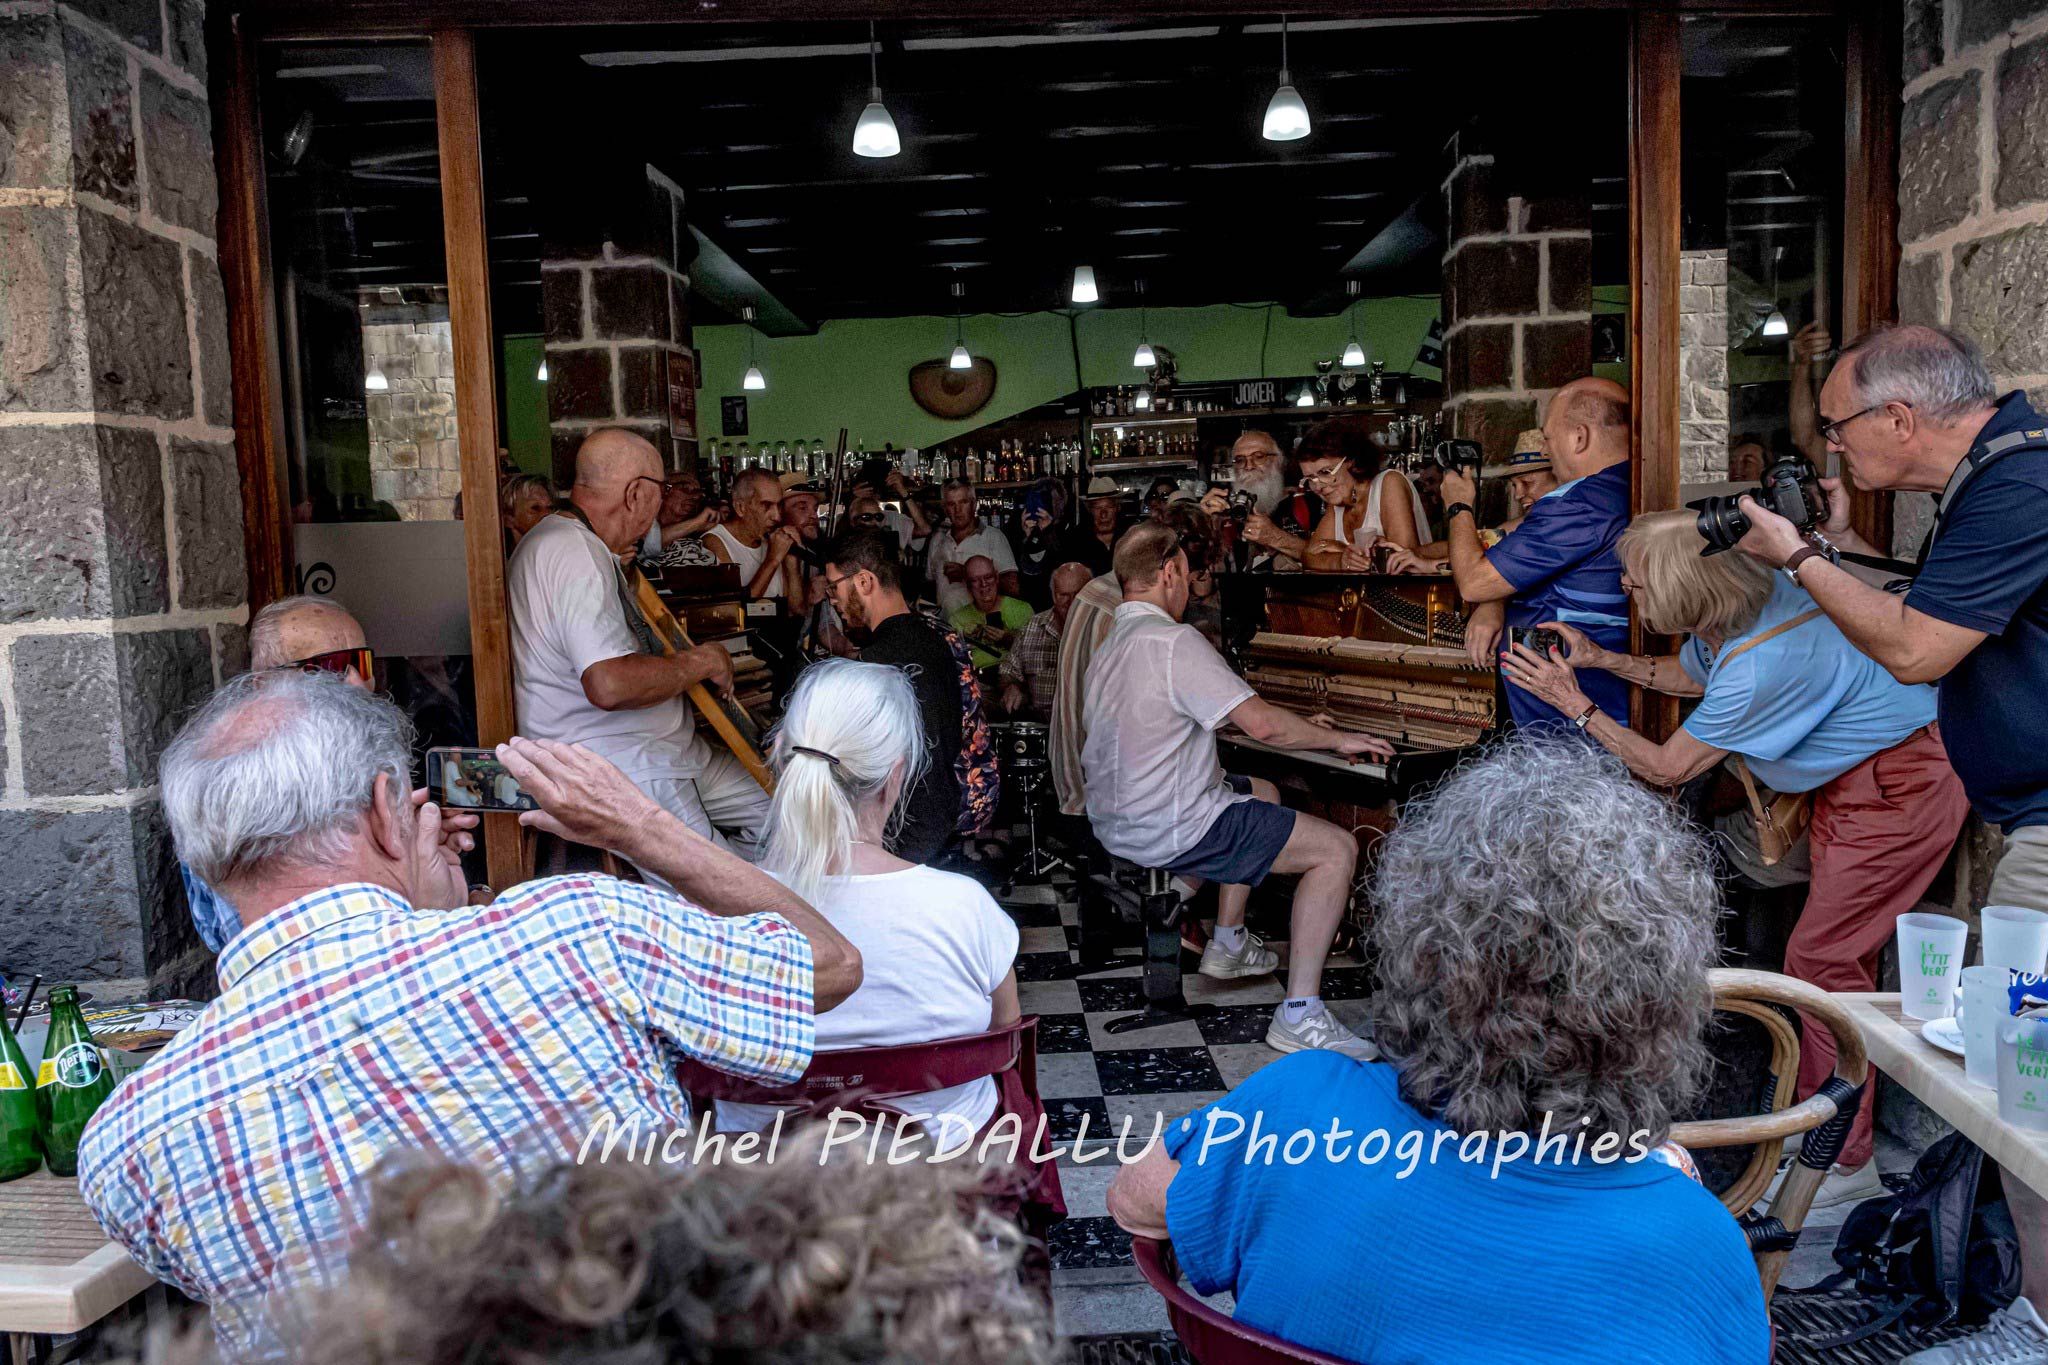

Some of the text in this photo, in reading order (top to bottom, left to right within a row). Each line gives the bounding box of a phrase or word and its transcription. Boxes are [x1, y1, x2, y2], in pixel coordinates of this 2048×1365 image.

[1235, 382, 1275, 404] JOKER
[1921, 964, 1949, 977] VERT
[1287, 1000, 1307, 1009] PUMA
